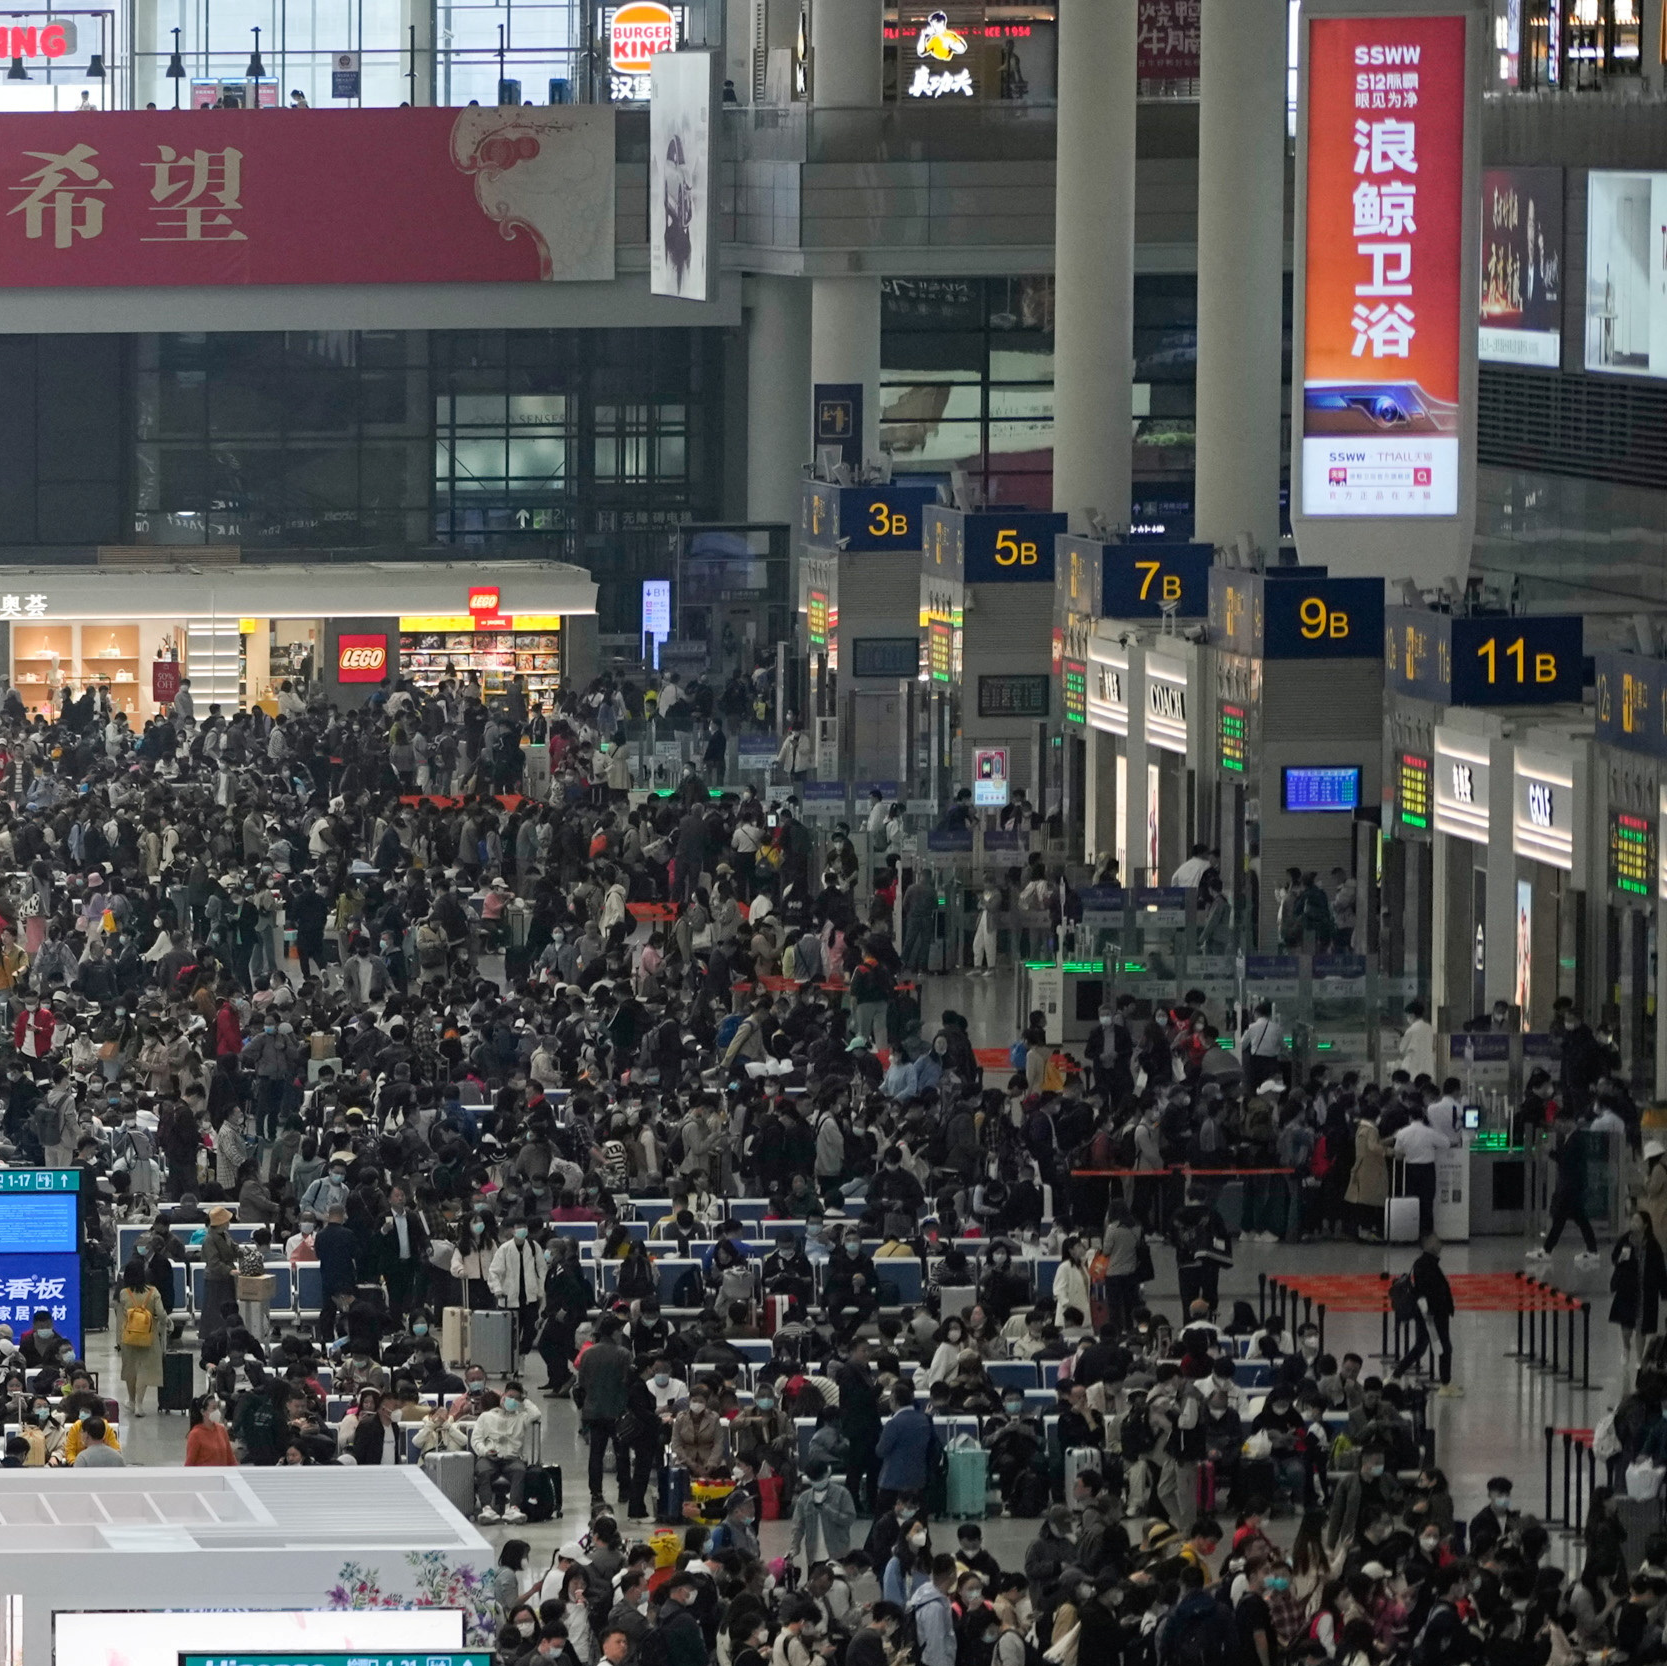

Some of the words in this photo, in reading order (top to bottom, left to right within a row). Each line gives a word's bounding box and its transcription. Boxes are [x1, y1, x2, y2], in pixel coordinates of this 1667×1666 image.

[612, 26, 673, 39] BURGER
[1004, 26, 1031, 38] 1954
[1354, 45, 1421, 65] SSWW
[908, 65, 974, 99] 真功夫
[1355, 91, 1419, 109] 眼见为净
[1350, 118, 1419, 361] 浪鲸卫浴
[1329, 452, 1366, 462] SSWW
[868, 502, 909, 537] 3B
[994, 529, 1039, 566] 5B
[1134, 561, 1182, 600] 7B
[469, 594, 498, 608] LEGO
[1299, 597, 1350, 640] 9B
[339, 646, 386, 670] LEGO
[1477, 637, 1557, 684] 11B
[1150, 684, 1186, 720] COACH
[8, 1173, 31, 1188] 1-17
